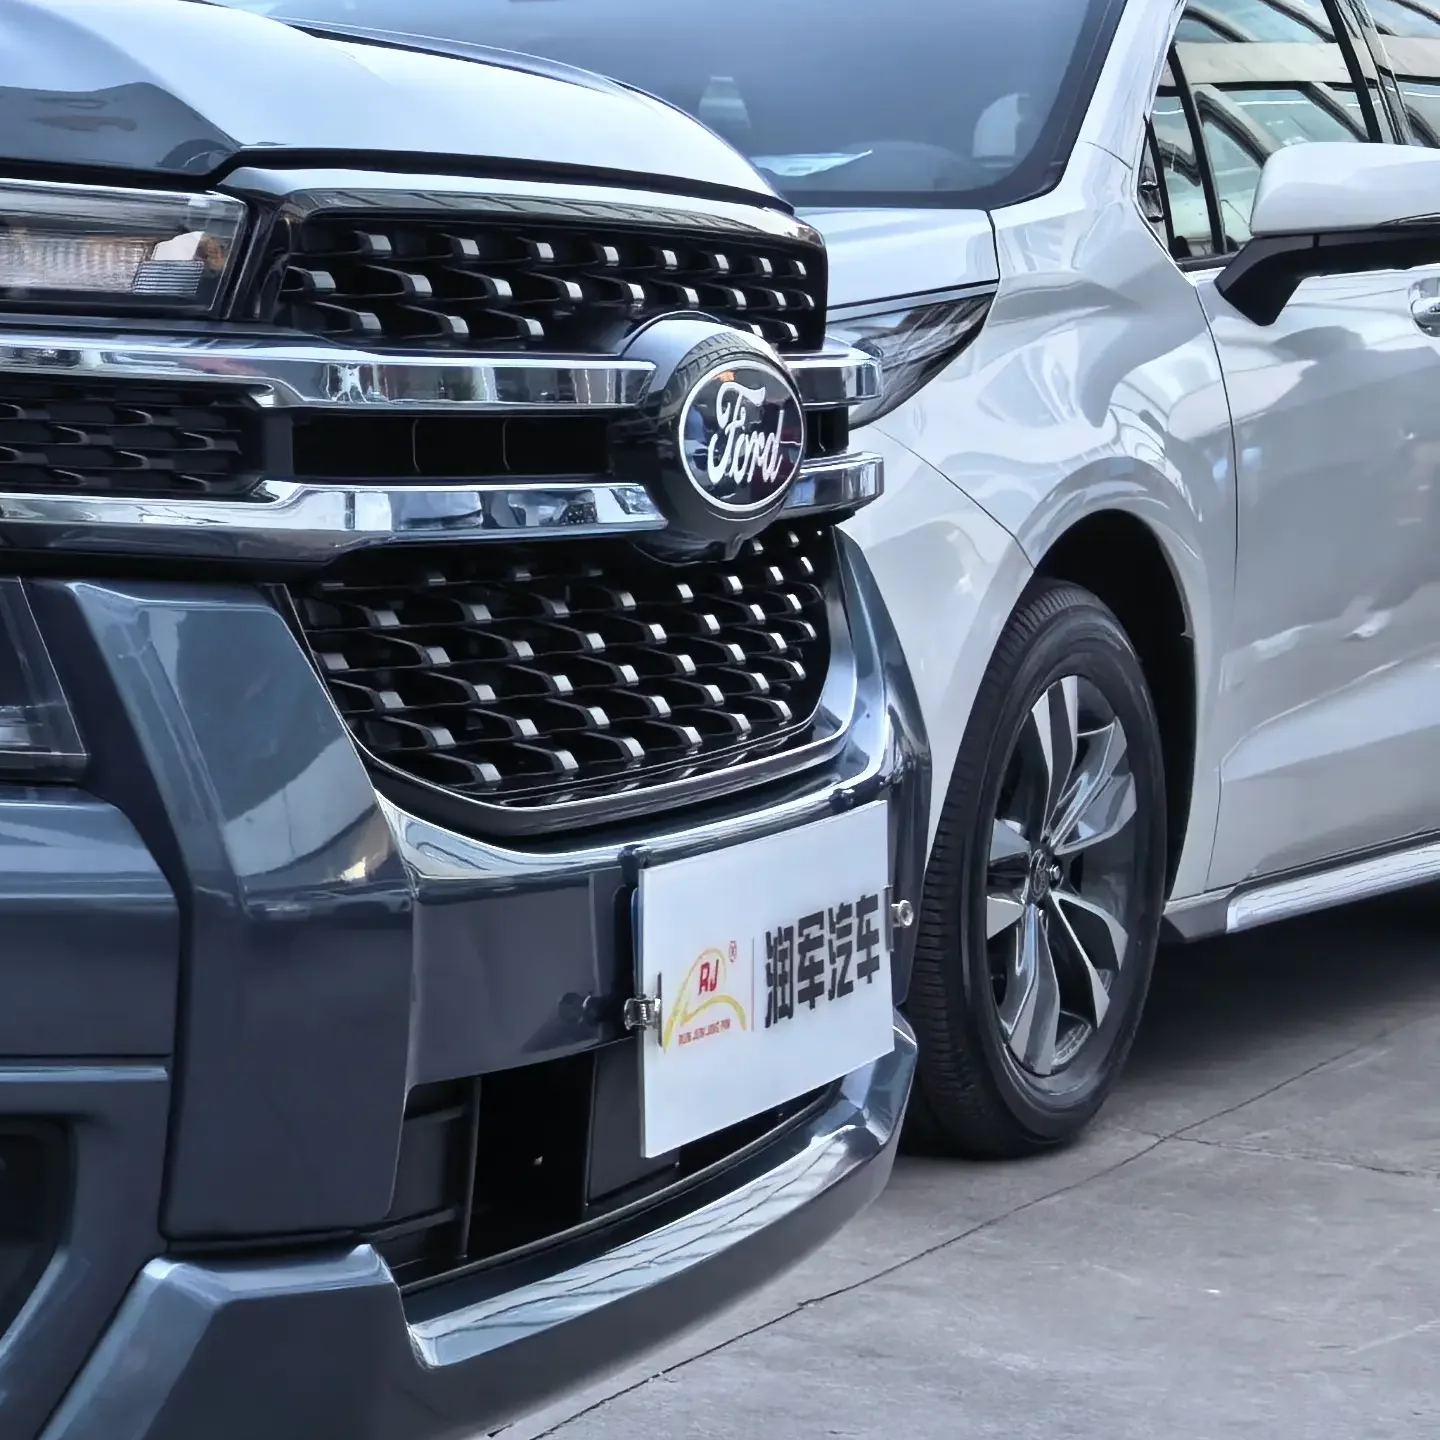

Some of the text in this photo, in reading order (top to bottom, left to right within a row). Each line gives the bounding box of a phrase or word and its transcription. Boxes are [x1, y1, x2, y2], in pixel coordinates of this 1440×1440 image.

[707, 382, 785, 485] Ford
[764, 893, 880, 1029] 润军汽车
